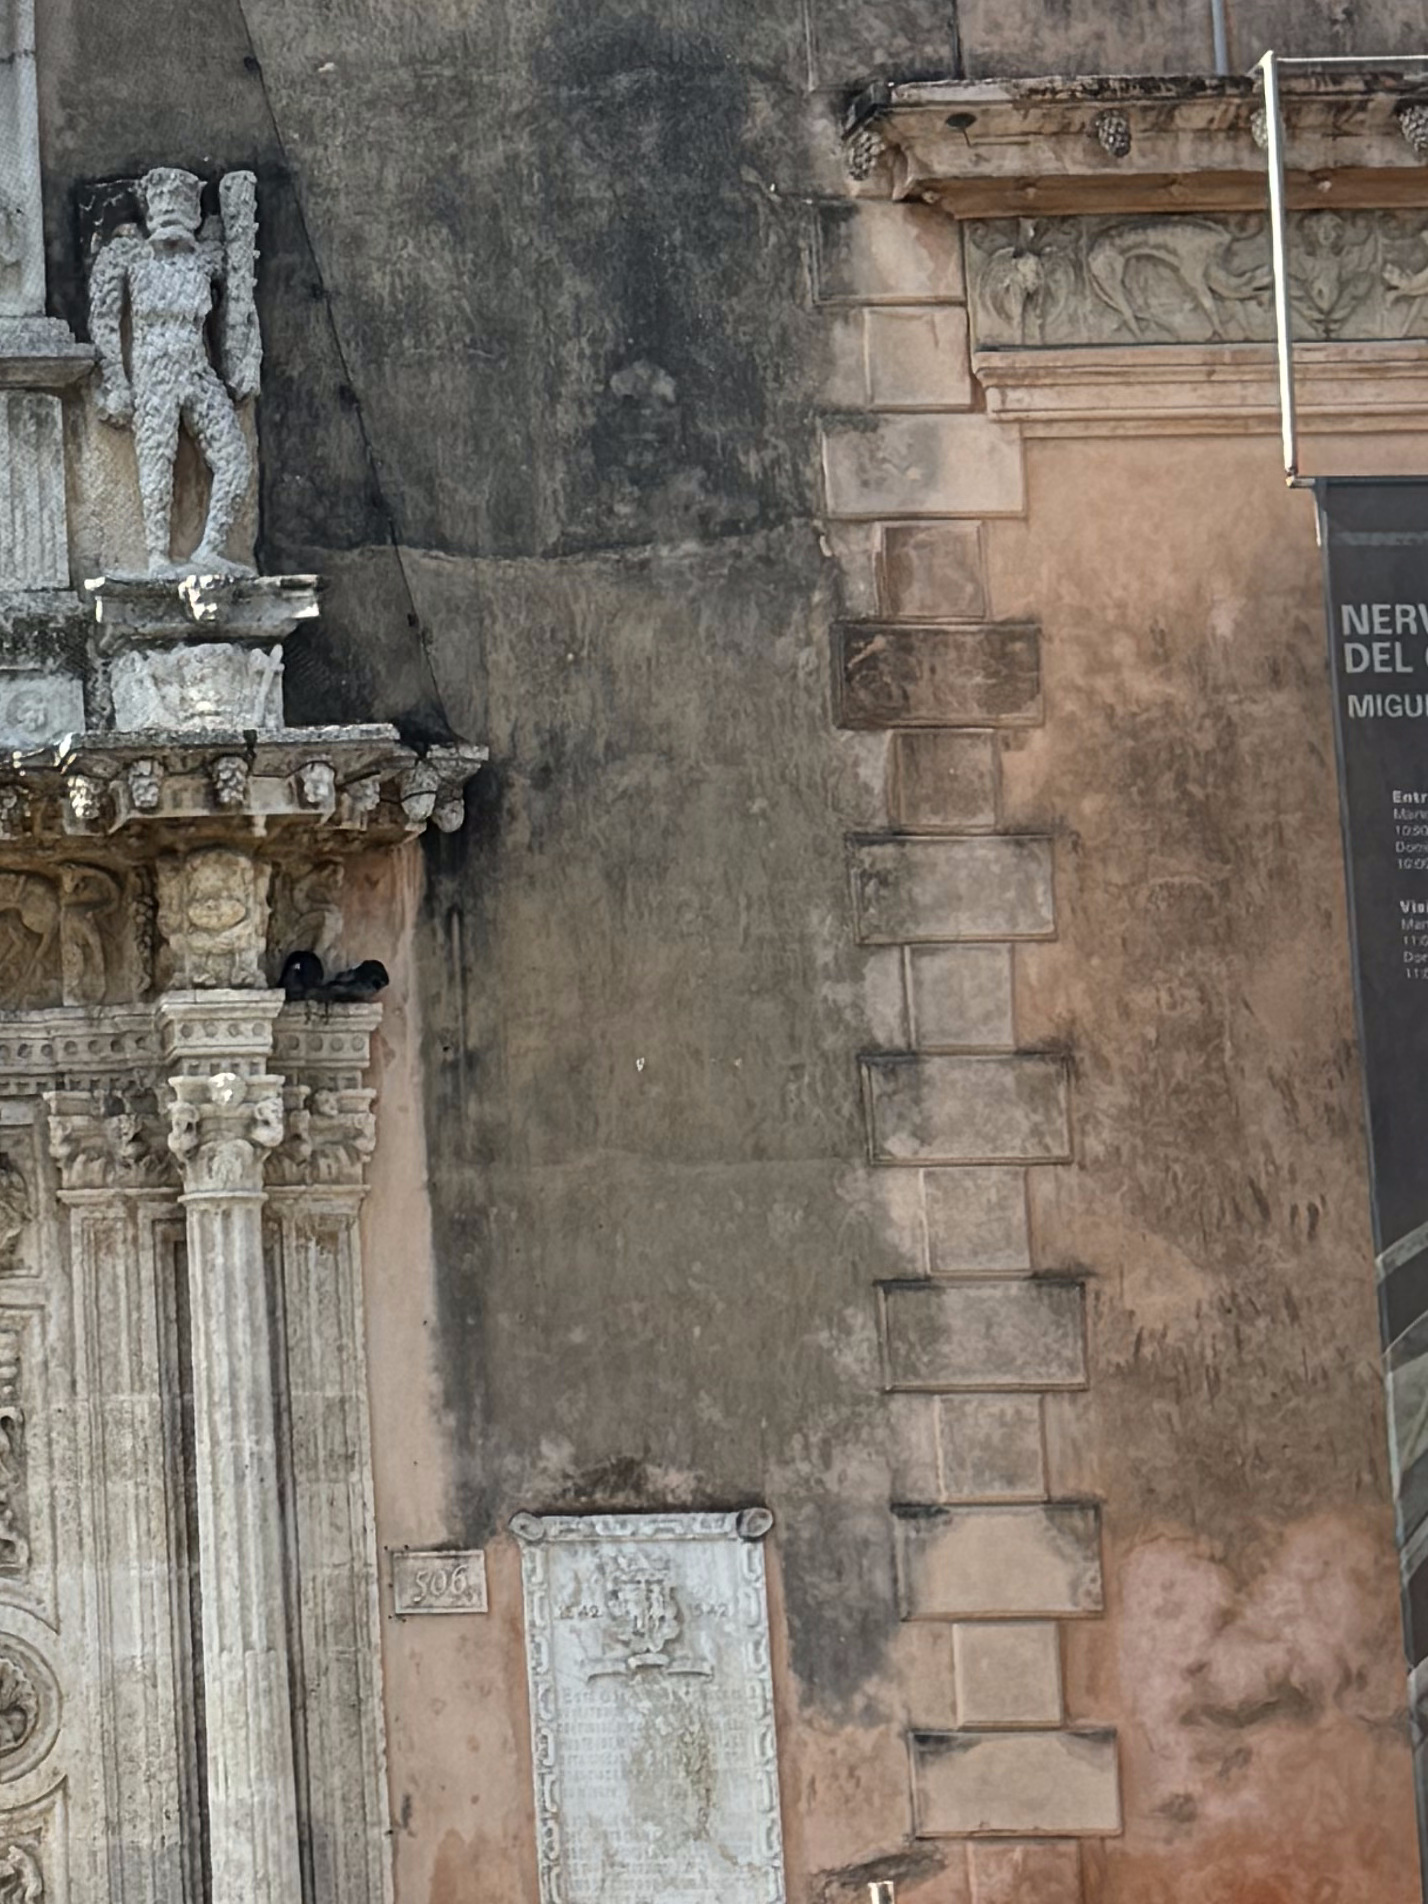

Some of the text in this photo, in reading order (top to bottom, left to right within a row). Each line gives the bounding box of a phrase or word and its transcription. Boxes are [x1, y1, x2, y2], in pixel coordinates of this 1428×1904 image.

[1344, 641, 1414, 674] DEL
[1347, 693, 1428, 719] MIGU
[413, 1564, 468, 1602] 506
